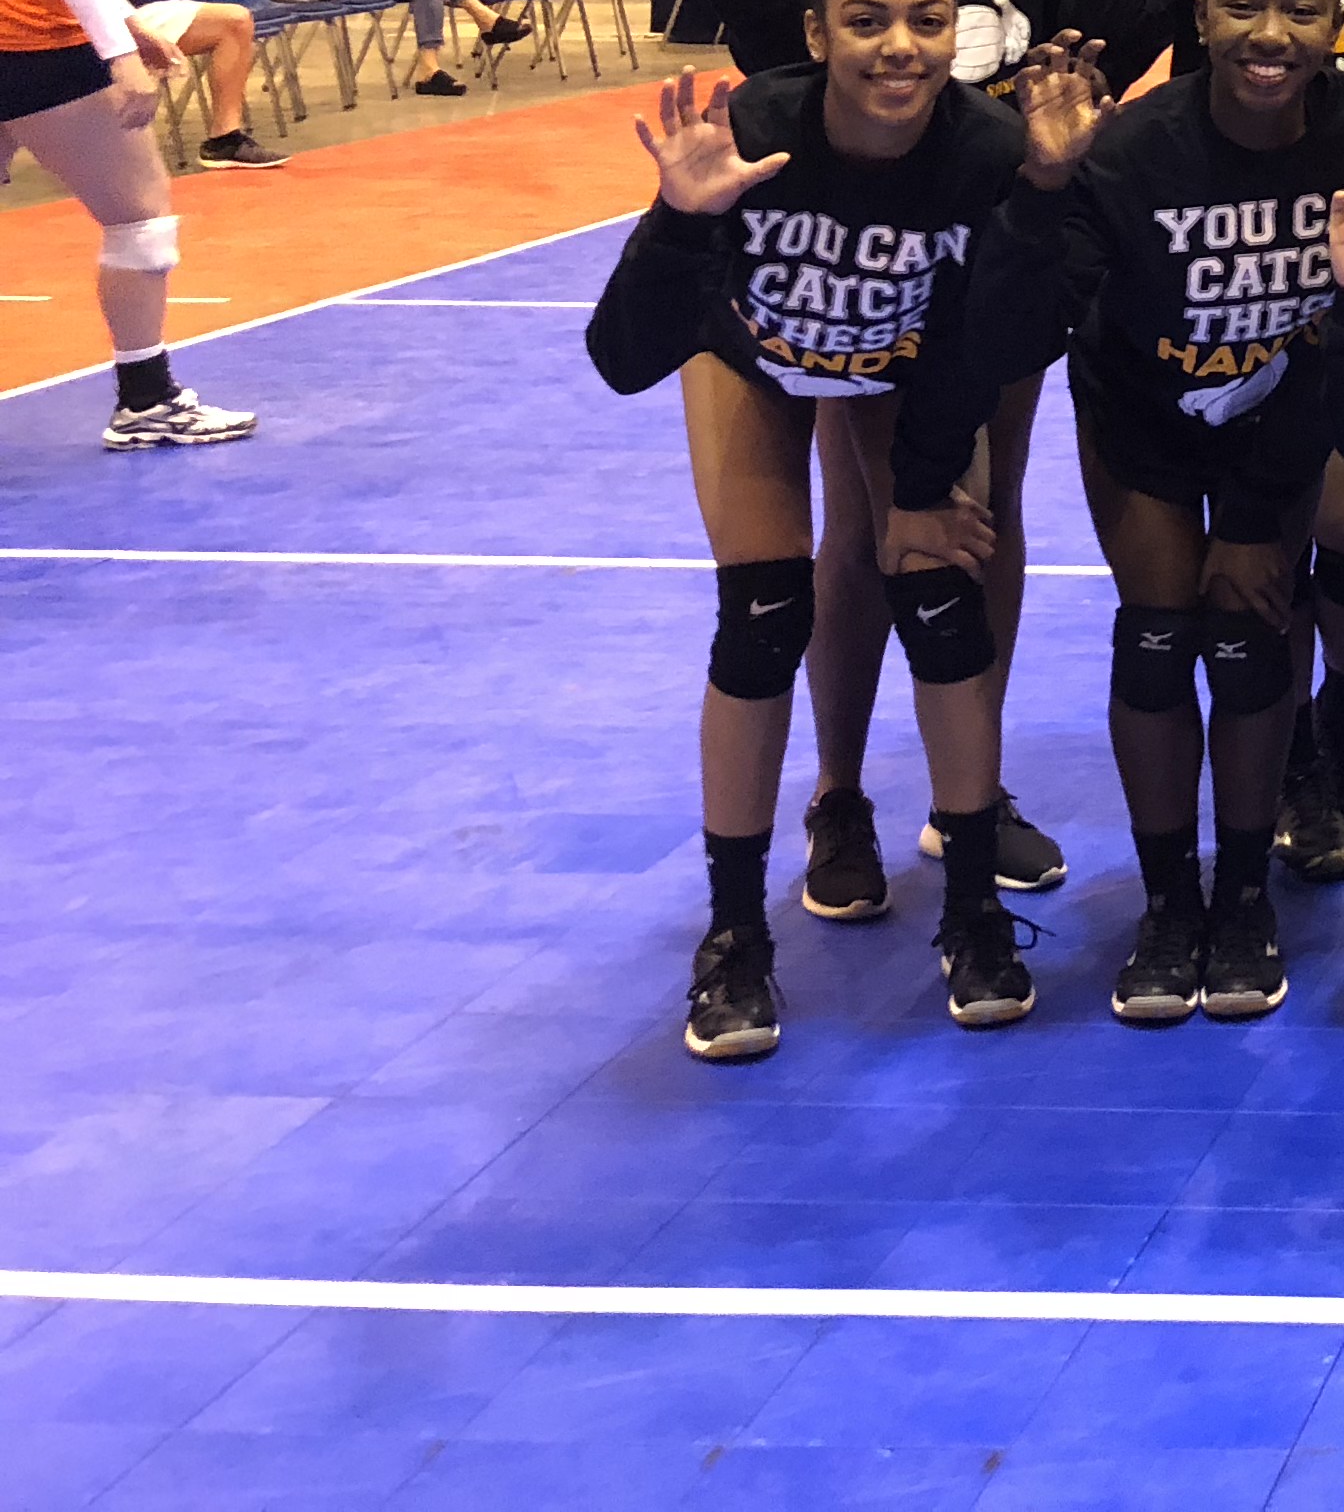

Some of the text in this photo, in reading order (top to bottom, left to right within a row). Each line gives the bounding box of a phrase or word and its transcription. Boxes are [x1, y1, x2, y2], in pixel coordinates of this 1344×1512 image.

[741, 209, 971, 274] YOU CAN
[1154, 199, 1278, 254] YOU
[748, 262, 937, 321] CATCH
[1185, 242, 1333, 302] CATC
[749, 295, 929, 353] THESE
